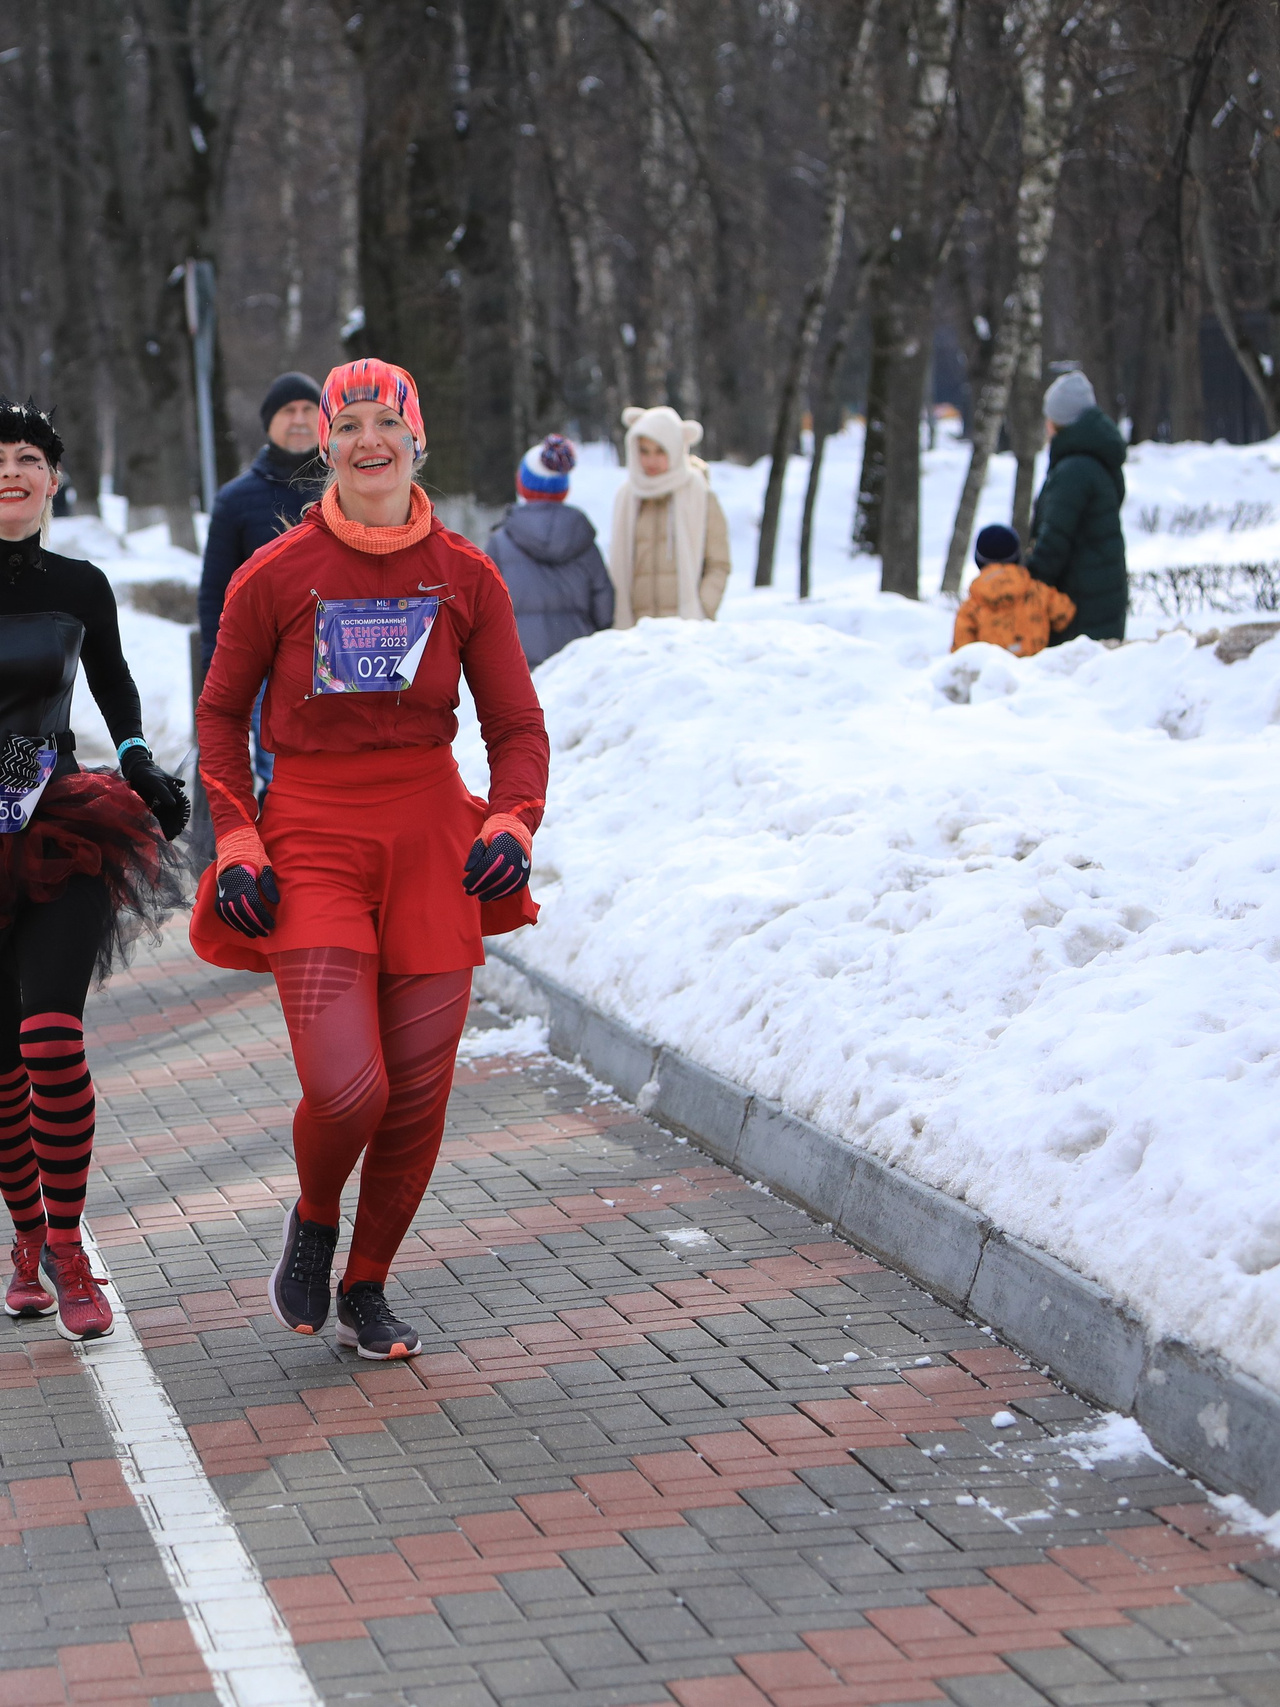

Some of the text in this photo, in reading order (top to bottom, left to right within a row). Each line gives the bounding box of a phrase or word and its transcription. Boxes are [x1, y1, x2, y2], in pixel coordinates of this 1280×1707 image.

[340, 617, 407, 626] КОСТЮМИРОВАННЫЙ
[341, 623, 408, 638] ЖЕНСКИЙ
[341, 637, 408, 649] ЗАБЕГ 2023
[358, 656, 402, 678] 027
[4, 784, 29, 794] 2023
